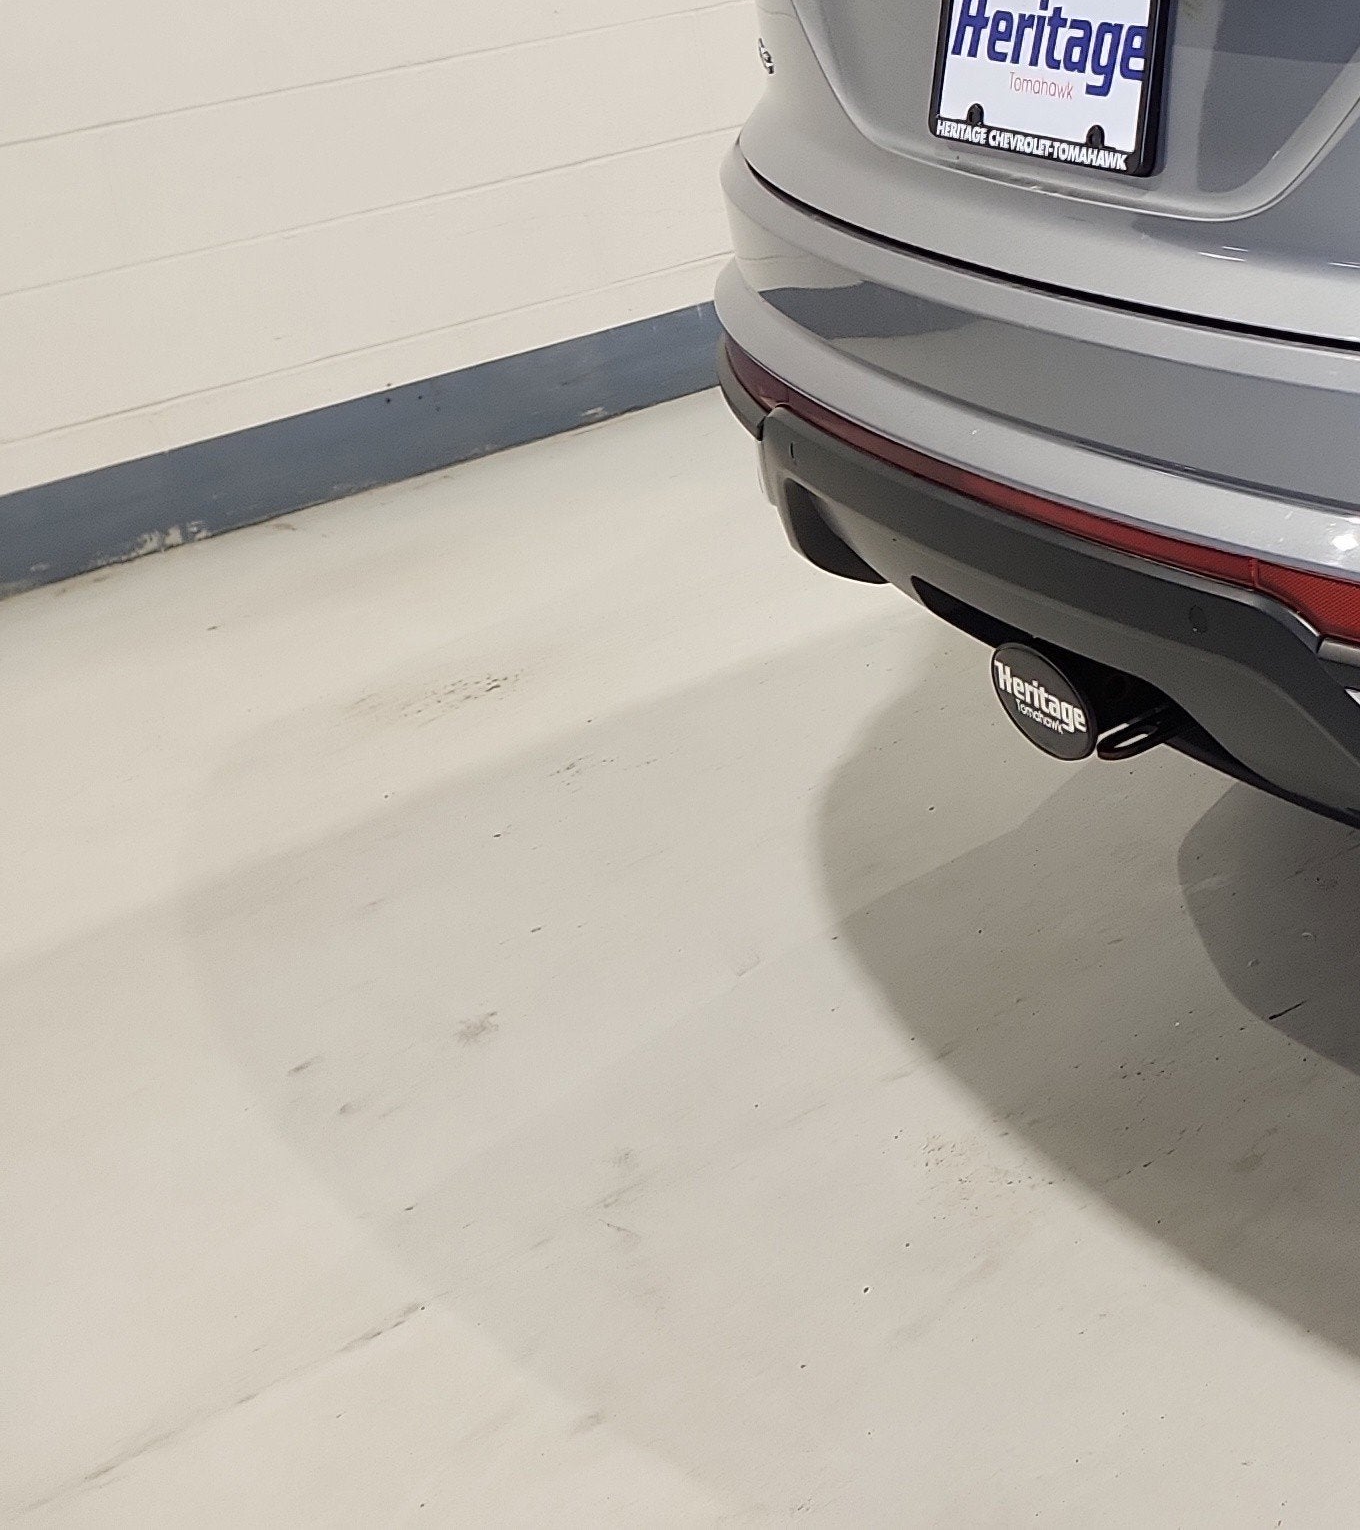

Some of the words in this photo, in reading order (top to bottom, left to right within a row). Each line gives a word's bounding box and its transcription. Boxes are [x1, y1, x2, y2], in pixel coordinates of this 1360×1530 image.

[1009, 72, 1074, 100] Tomahawk
[936, 120, 988, 145] HERITAGE
[994, 660, 1087, 733] Heritage
[1015, 699, 1064, 734] Tomahawk
